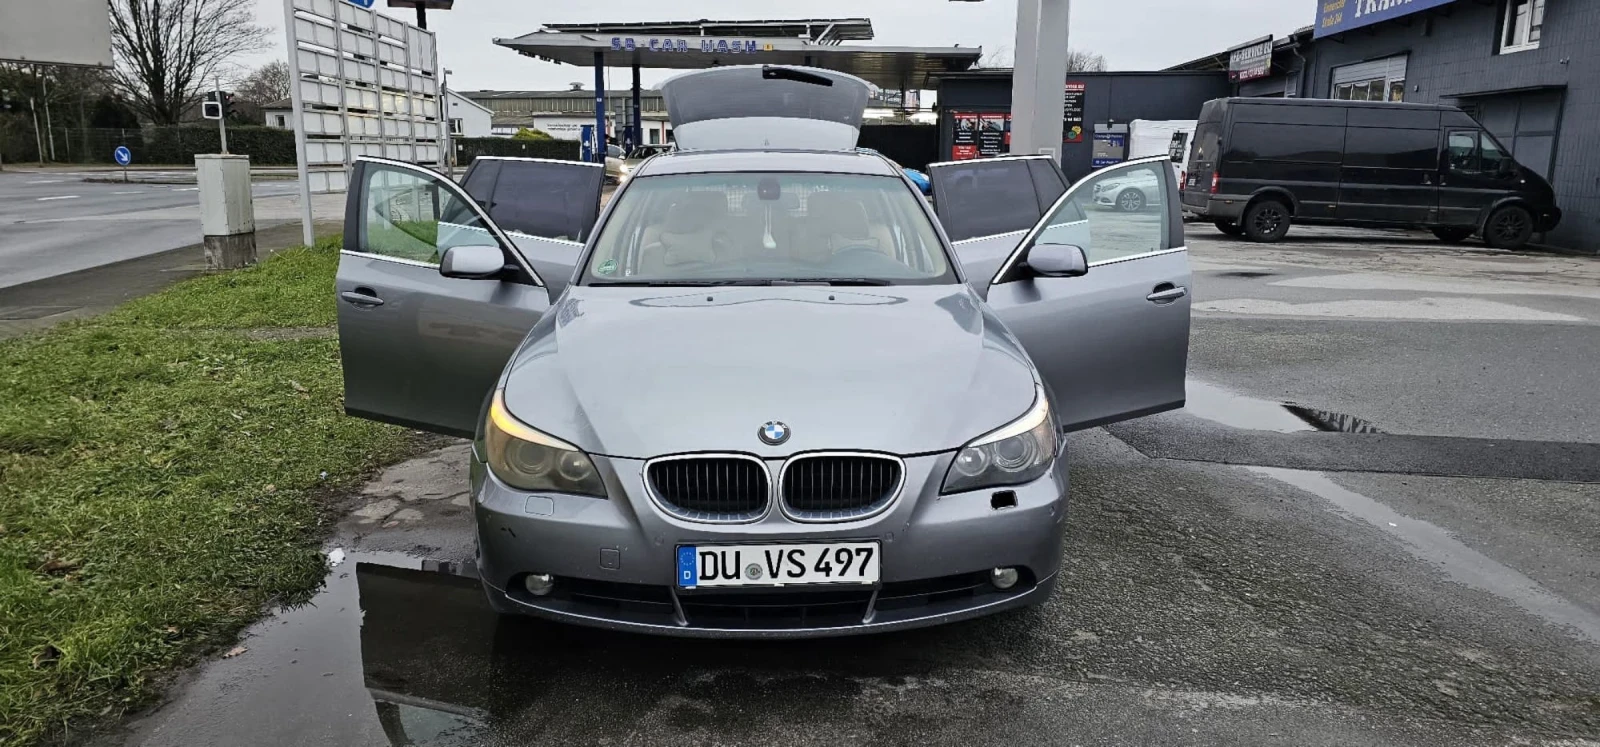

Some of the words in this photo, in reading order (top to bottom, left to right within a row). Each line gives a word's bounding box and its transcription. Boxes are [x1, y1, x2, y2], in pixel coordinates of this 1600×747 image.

[702, 39, 757, 54] WASH
[699, 550, 741, 581] DU
[764, 549, 807, 579] VS
[814, 547, 874, 578] 497
[683, 570, 691, 580] D
